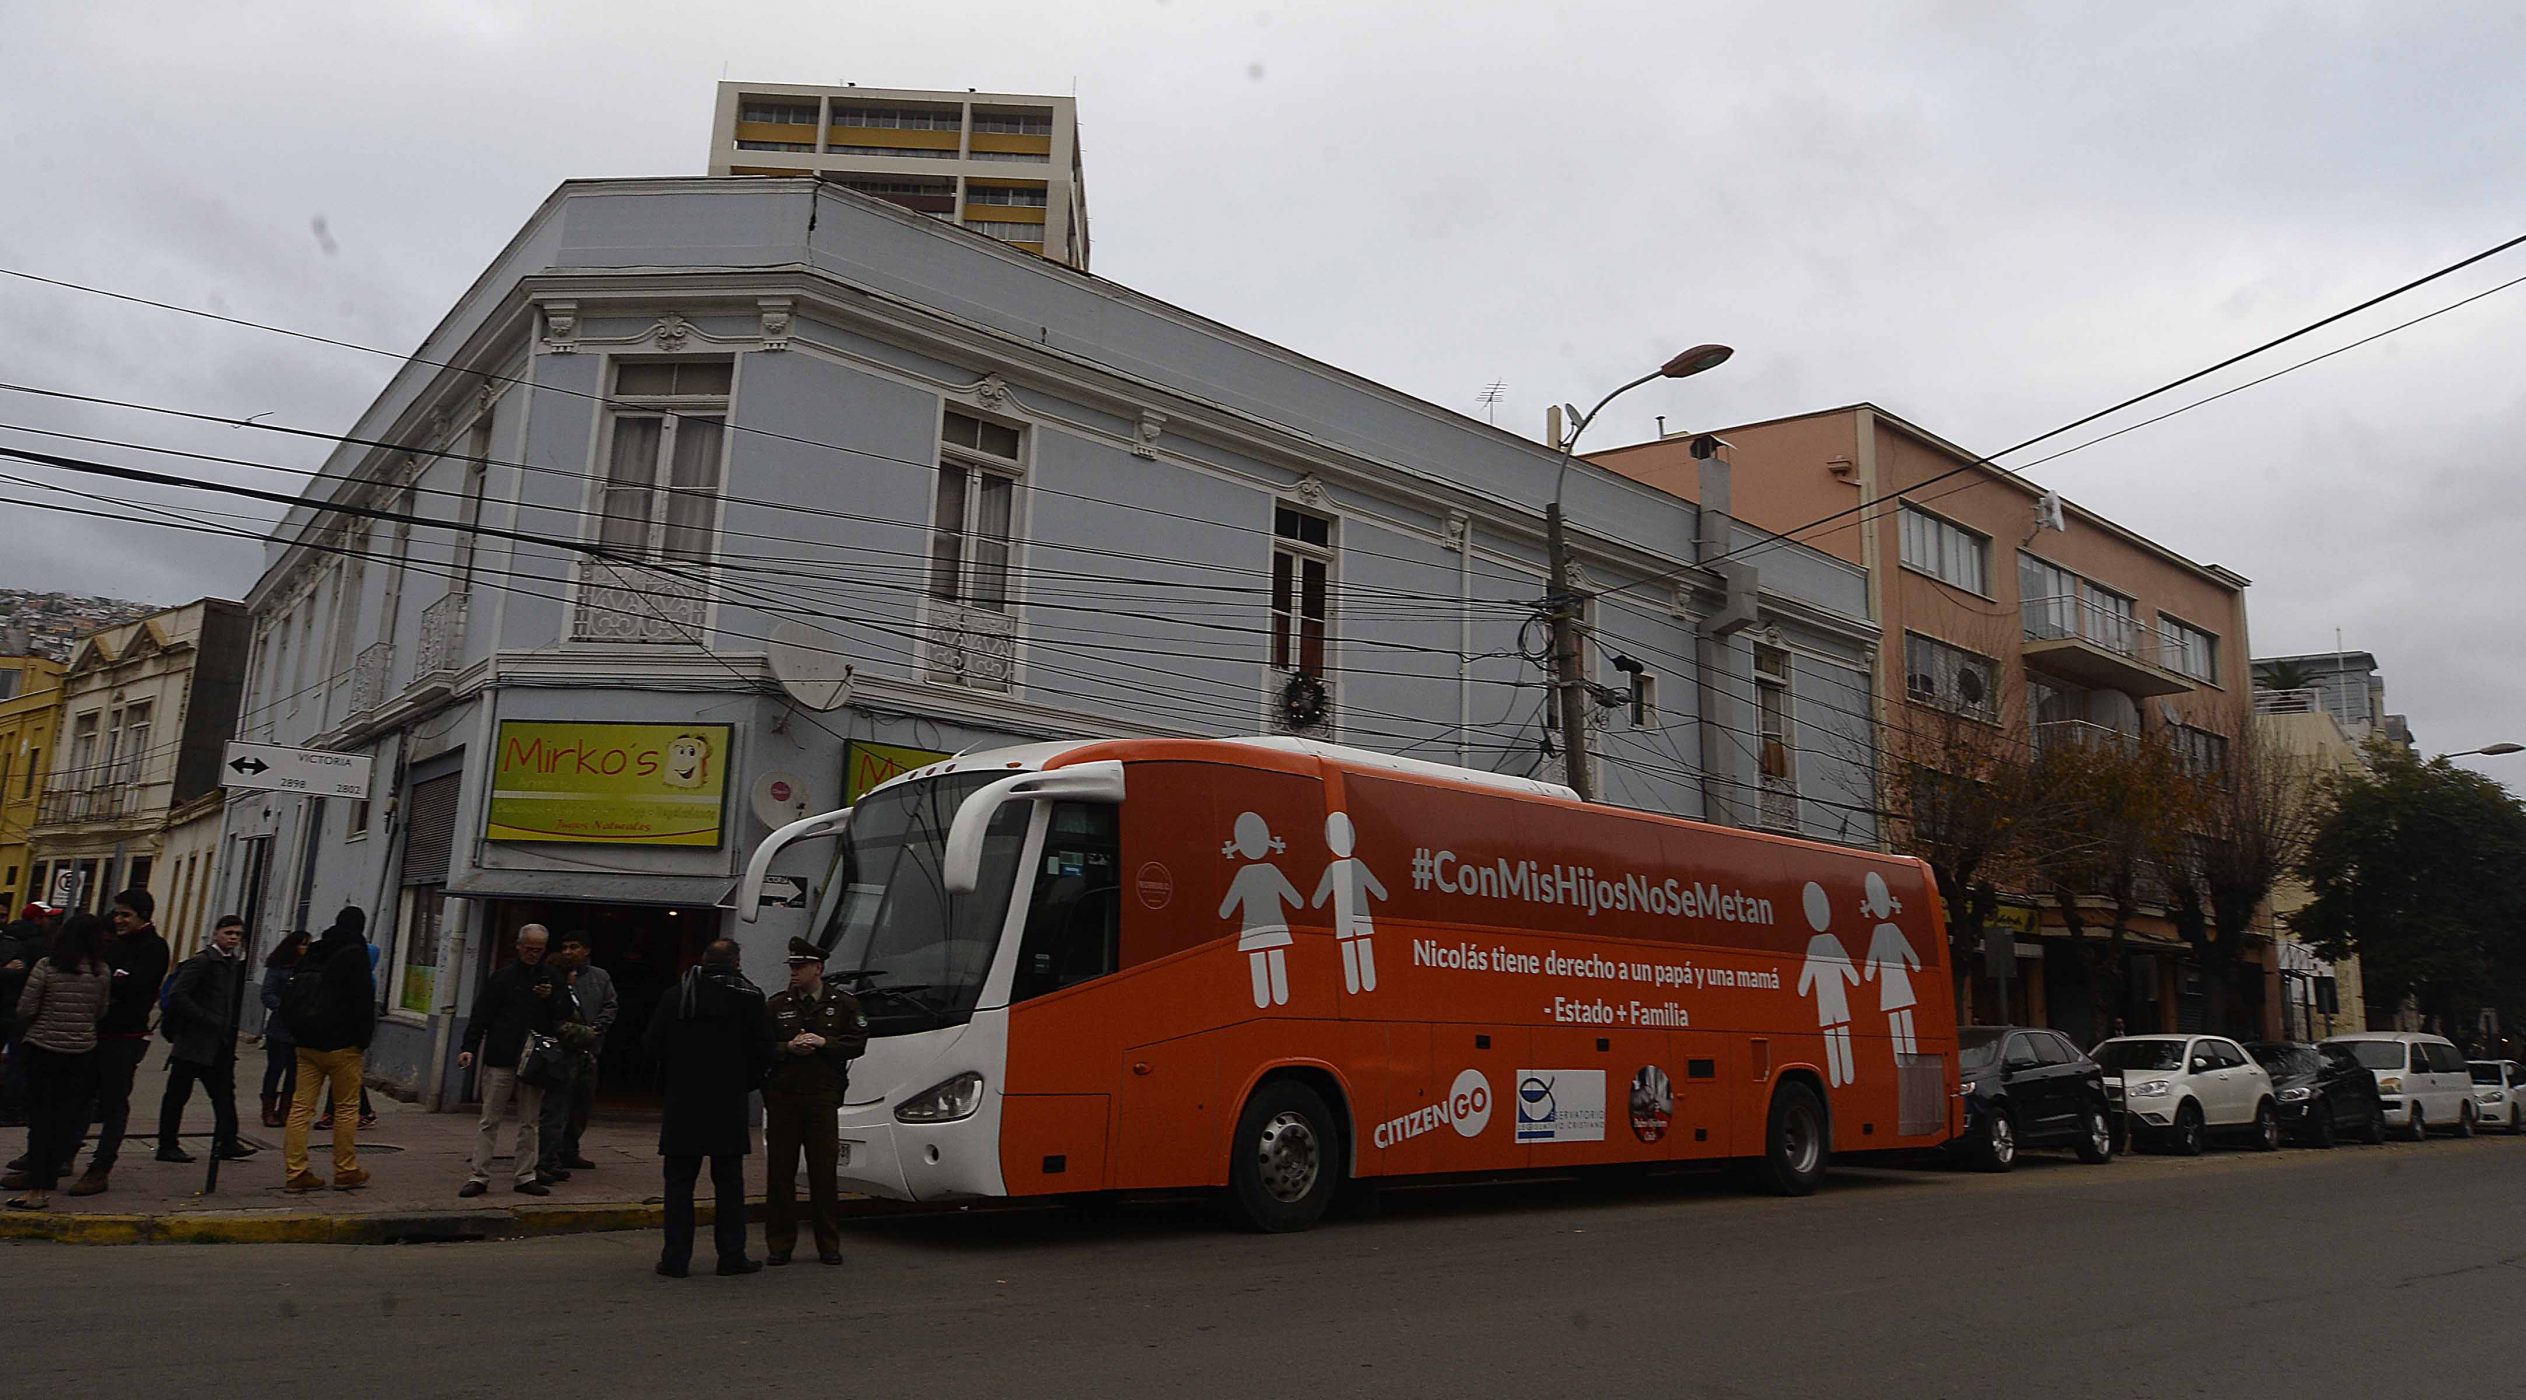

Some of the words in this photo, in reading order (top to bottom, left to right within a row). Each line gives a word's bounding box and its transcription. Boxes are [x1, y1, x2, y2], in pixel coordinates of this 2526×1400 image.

[299, 753, 352, 767] VICTORIA
[281, 778, 306, 789] 2898
[336, 784, 361, 794] 2802
[1412, 847, 1774, 925] #ConMisHijosNoSeMetan
[1413, 938, 1488, 971] Nicolás
[1491, 945, 1540, 974] tiene
[1545, 949, 1616, 980] derecho
[1618, 962, 1629, 980] a
[1631, 962, 1652, 982] un
[1655, 960, 1693, 988] papá
[1694, 967, 1705, 989] y
[1707, 967, 1735, 987] una
[1737, 967, 1780, 989] mamá
[1554, 996, 1613, 1024] Estado
[1616, 1004, 1628, 1022] +
[1630, 1000, 1689, 1027] Familia
[1373, 1100, 1450, 1149] CITIZEN
[1453, 1086, 1487, 1120] GO
